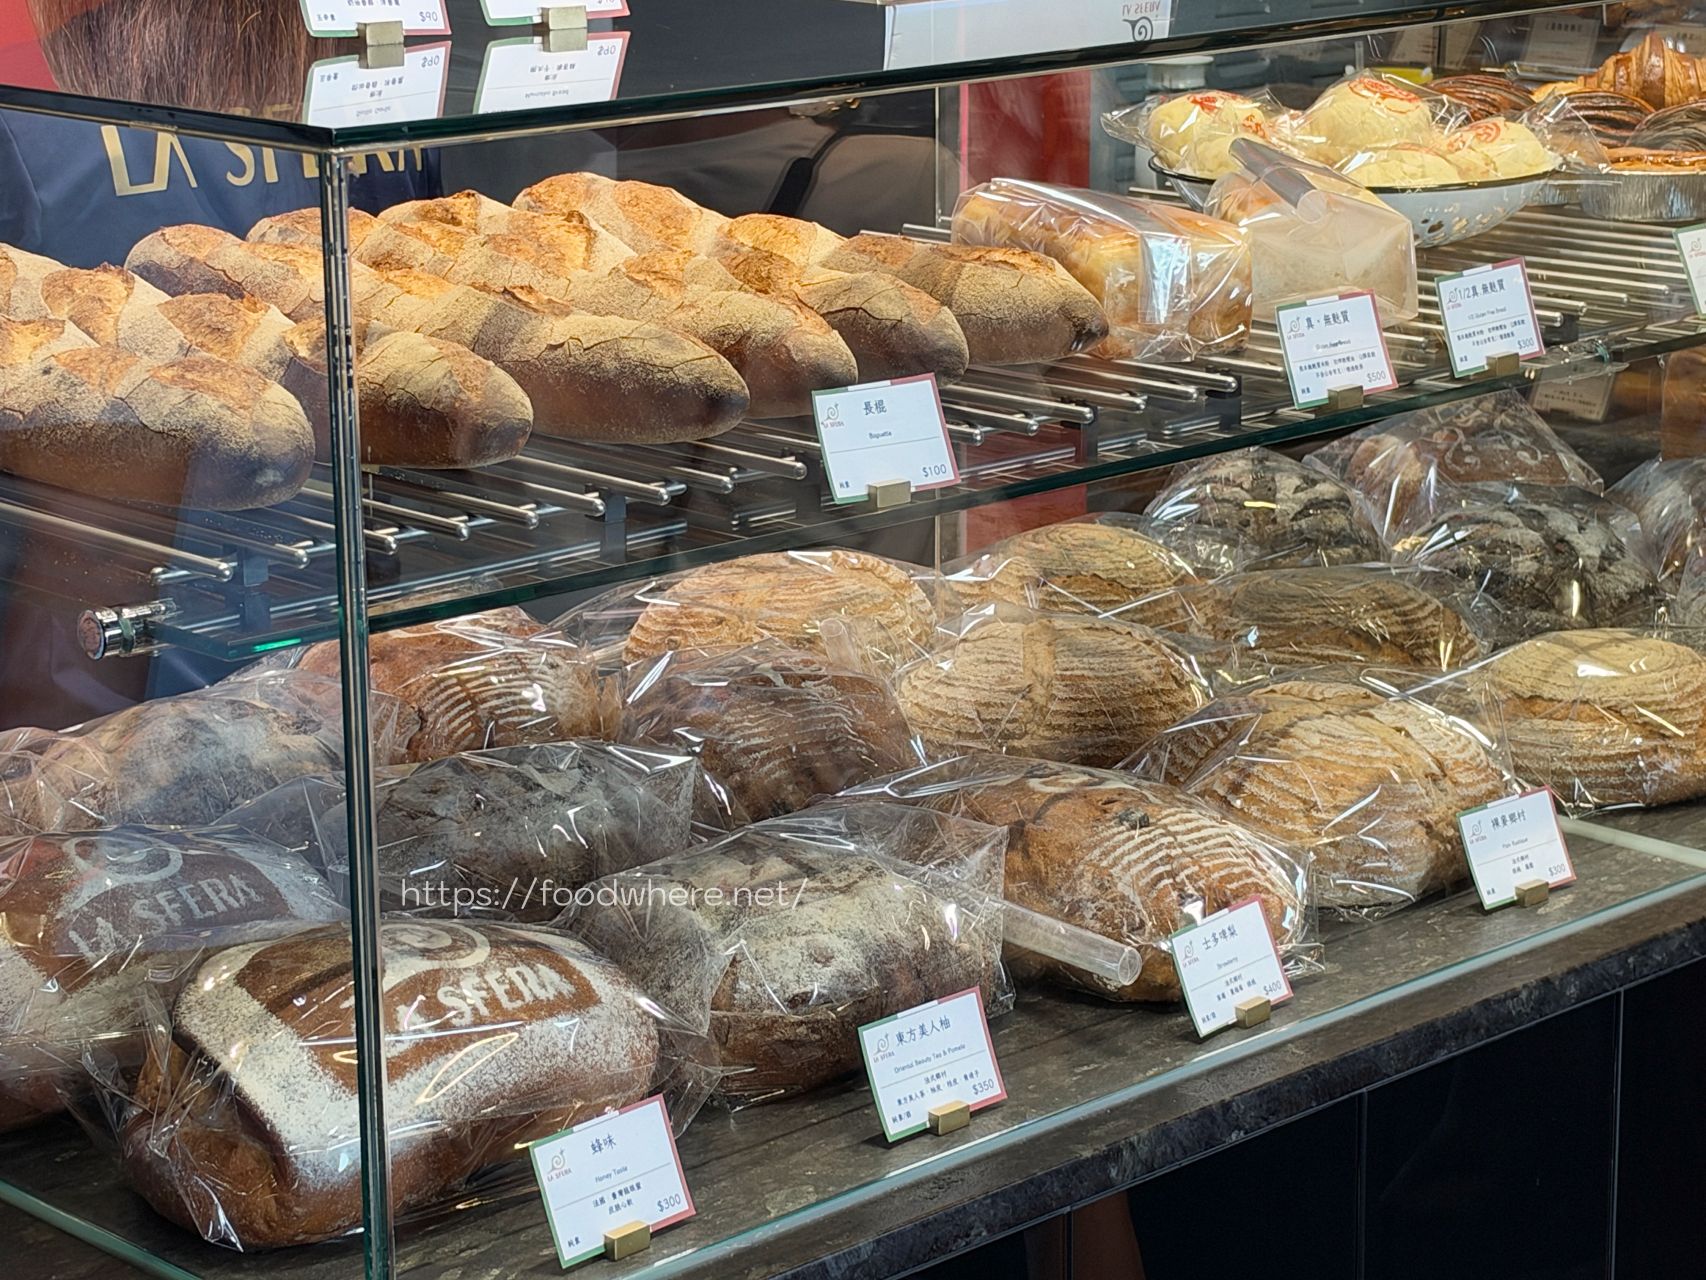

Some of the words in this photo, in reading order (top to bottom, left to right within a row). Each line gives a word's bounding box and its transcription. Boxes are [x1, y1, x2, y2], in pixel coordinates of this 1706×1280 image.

[419, 11, 438, 22] $90
[1367, 370, 1386, 384] $500
[864, 399, 887, 416] 長棍
[922, 464, 947, 478] $100
[1548, 863, 1566, 878] $300
[133, 872, 265, 933] SFERA
[1202, 923, 1238, 951] 士多啤梨
[437, 963, 578, 1027] SFERA
[1263, 980, 1282, 997] $400
[895, 1015, 951, 1047] 東方美人柚
[972, 1079, 994, 1096] $350
[591, 1134, 617, 1155] 蜂味
[595, 1170, 613, 1184] Honey
[657, 1193, 681, 1213] $300
